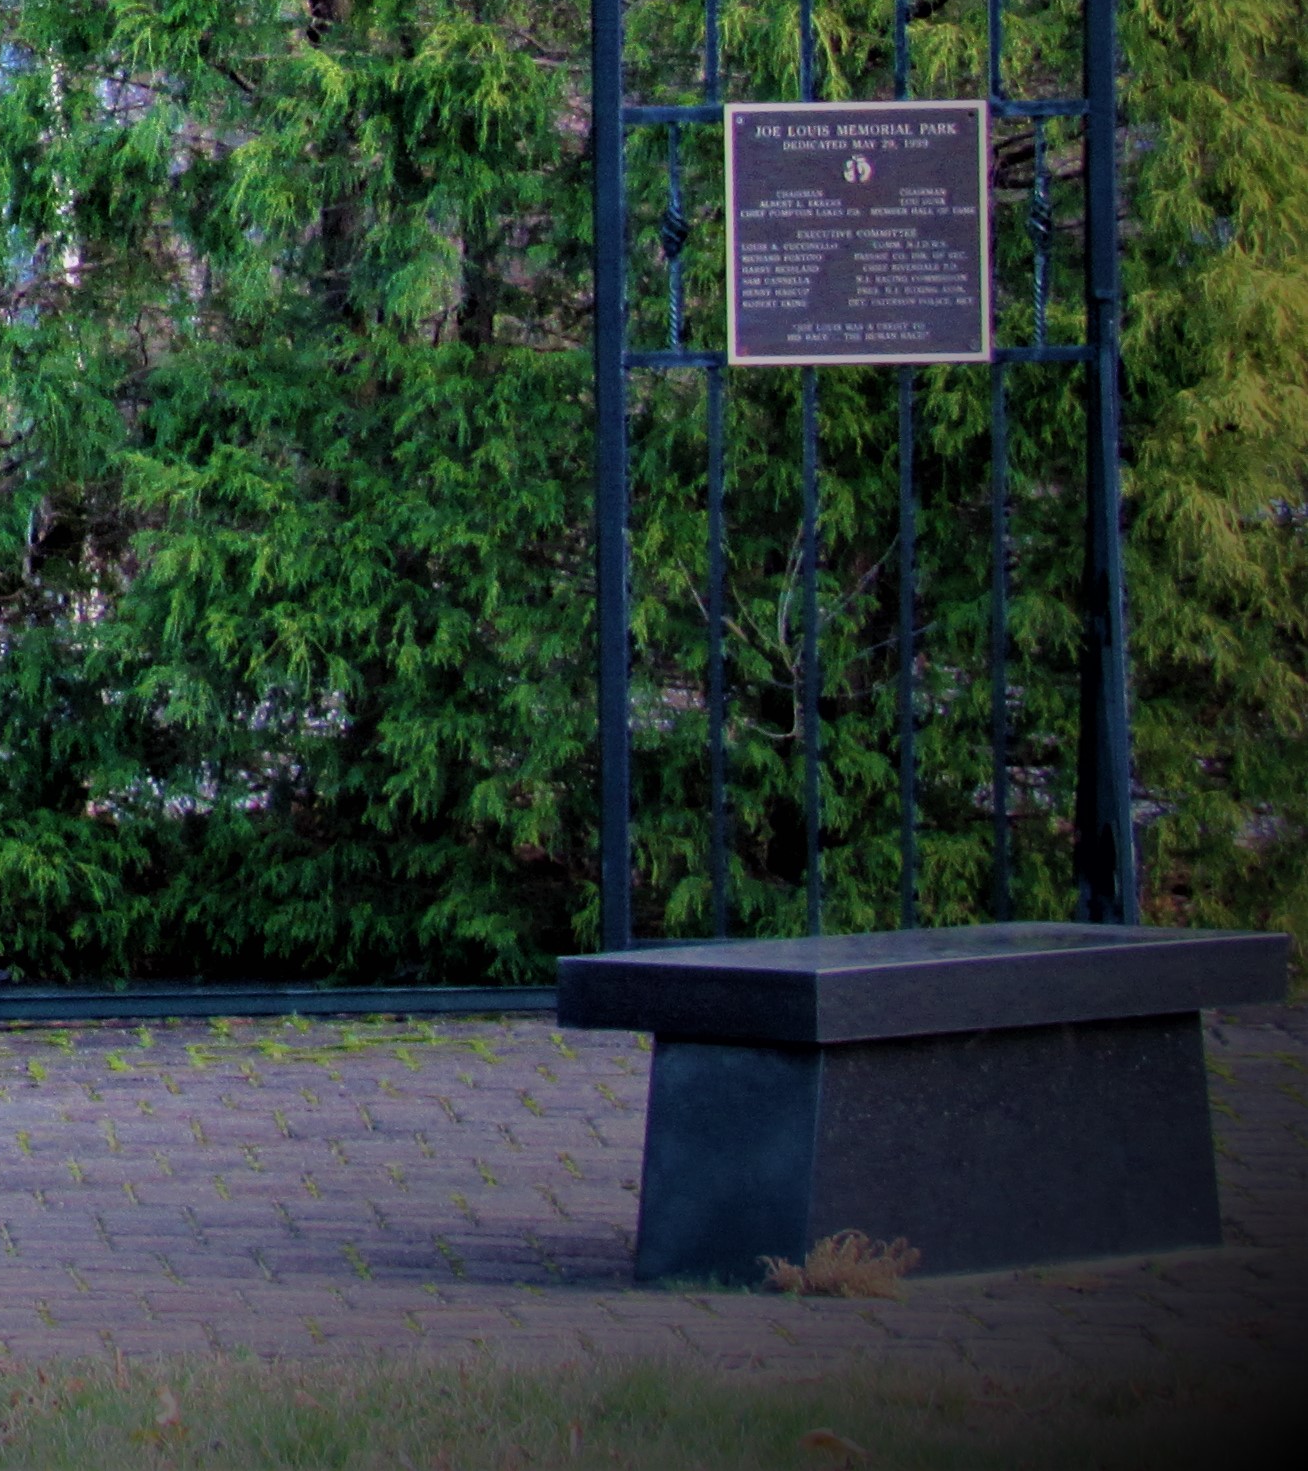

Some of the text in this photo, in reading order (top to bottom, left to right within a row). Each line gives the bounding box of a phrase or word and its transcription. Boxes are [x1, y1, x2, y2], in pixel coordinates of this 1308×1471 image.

[755, 122, 957, 138] JOE LOUIS MEMORIAL PARK
[783, 140, 848, 151] DEDICATED
[852, 140, 876, 150] MAY
